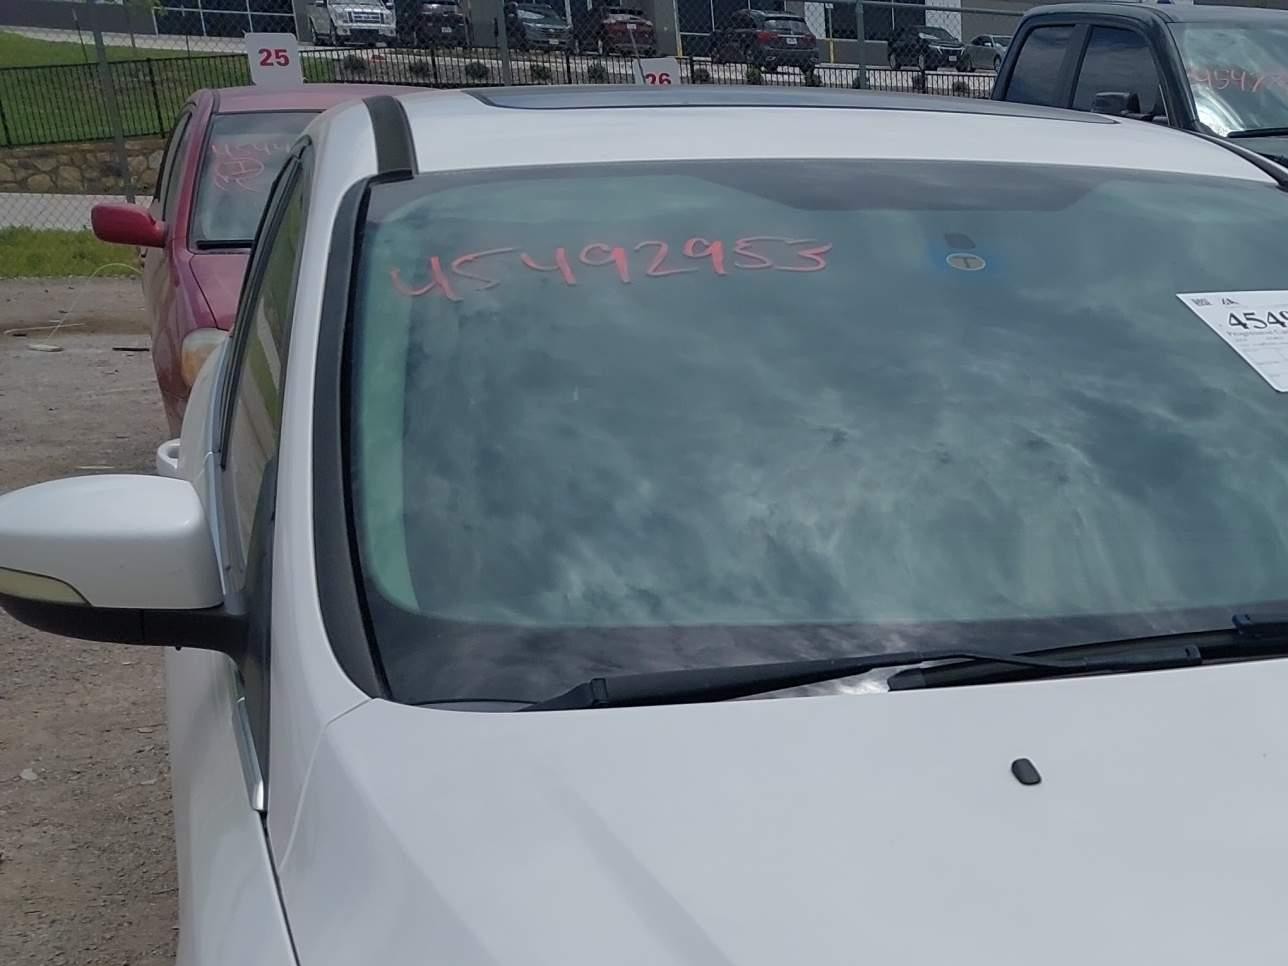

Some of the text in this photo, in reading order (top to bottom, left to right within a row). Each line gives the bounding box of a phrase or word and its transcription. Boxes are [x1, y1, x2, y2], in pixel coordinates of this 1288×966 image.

[258, 47, 290, 67] 25
[645, 72, 672, 85] 26
[390, 236, 833, 302] 45492953
